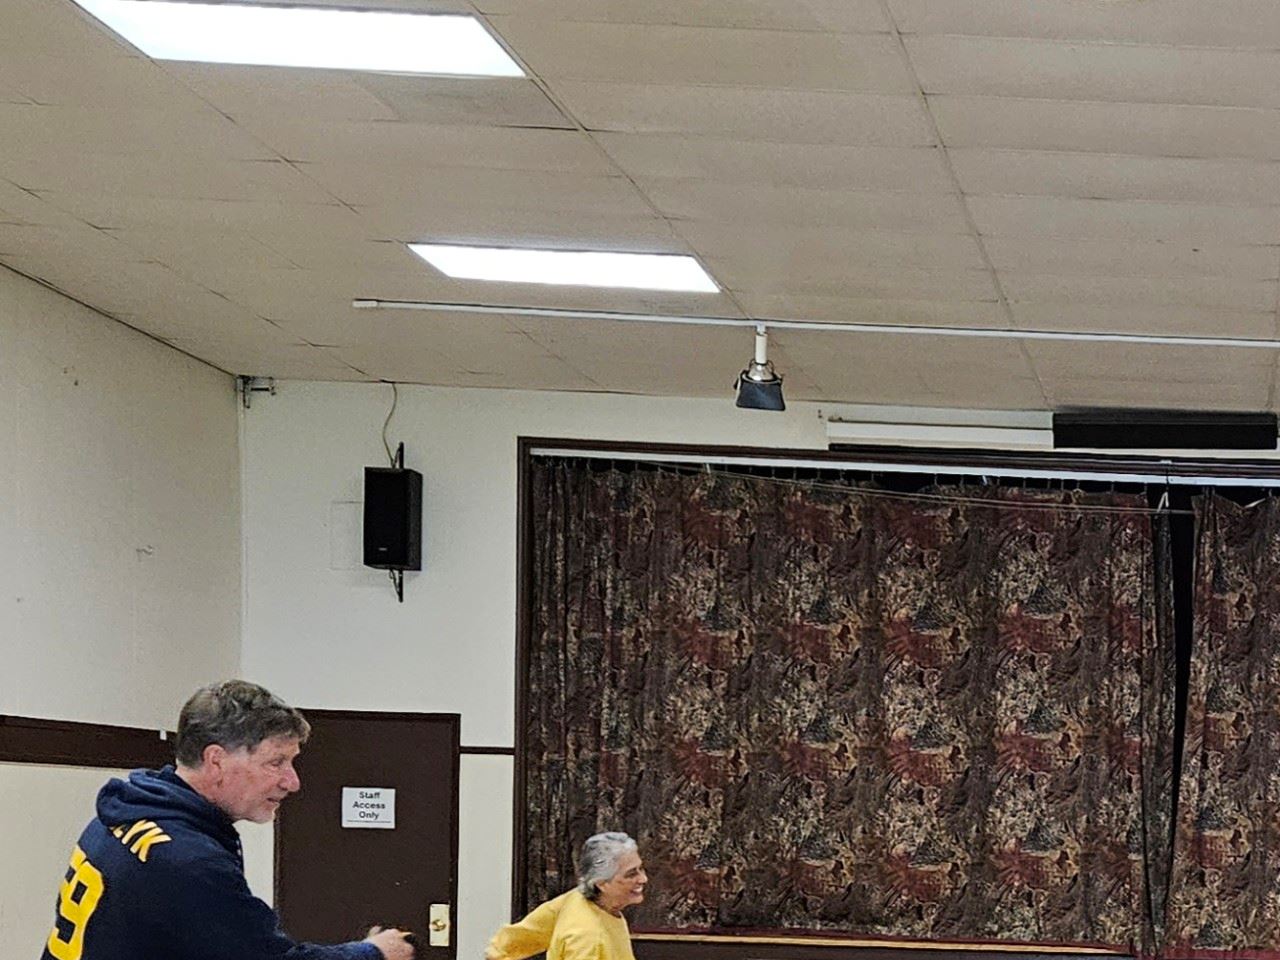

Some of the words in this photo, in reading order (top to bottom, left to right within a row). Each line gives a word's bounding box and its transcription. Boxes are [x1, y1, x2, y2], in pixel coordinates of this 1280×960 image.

[359, 791, 381, 799] Staff
[352, 801, 386, 809] Access
[359, 811, 379, 820] Only
